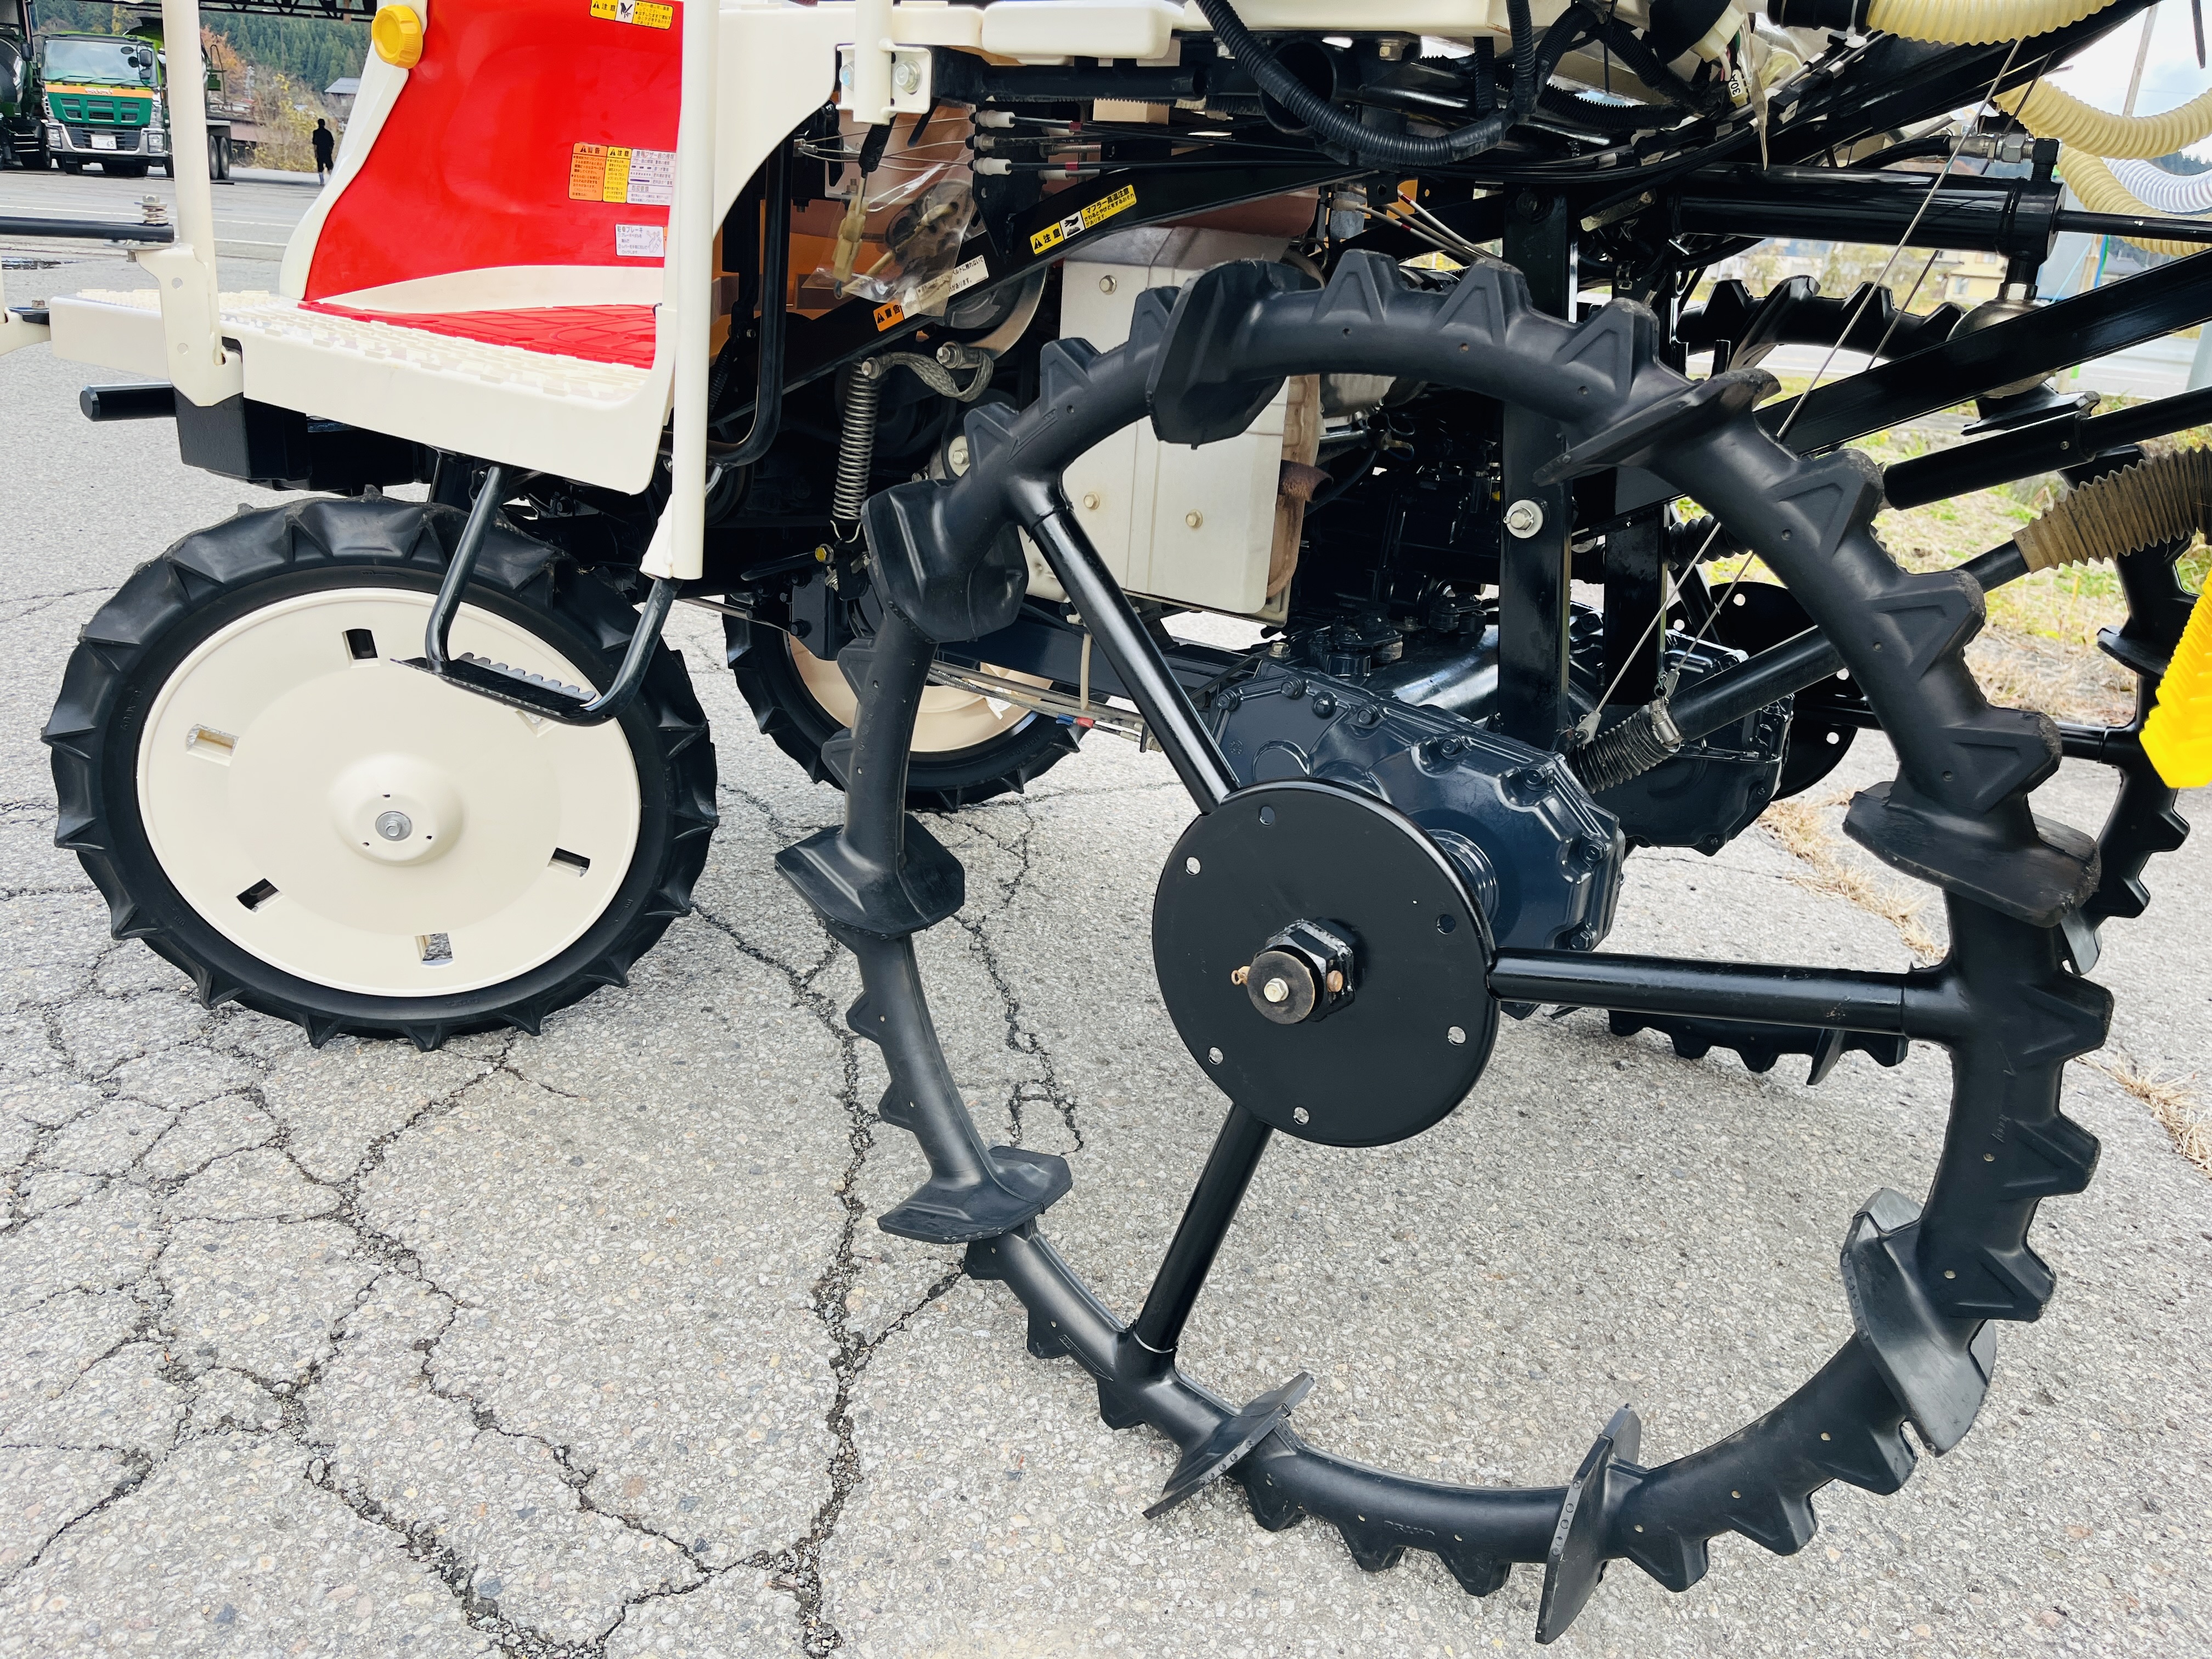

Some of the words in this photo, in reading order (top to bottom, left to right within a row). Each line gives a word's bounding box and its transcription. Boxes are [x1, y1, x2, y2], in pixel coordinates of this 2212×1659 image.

[1730, 74, 1741, 95] 30A
[1085, 187, 1130, 215] マフラー高温注意
[1086, 212, 1107, 228] があります。
[1043, 228, 1061, 243] 注意
[885, 304, 900, 318] 警告
